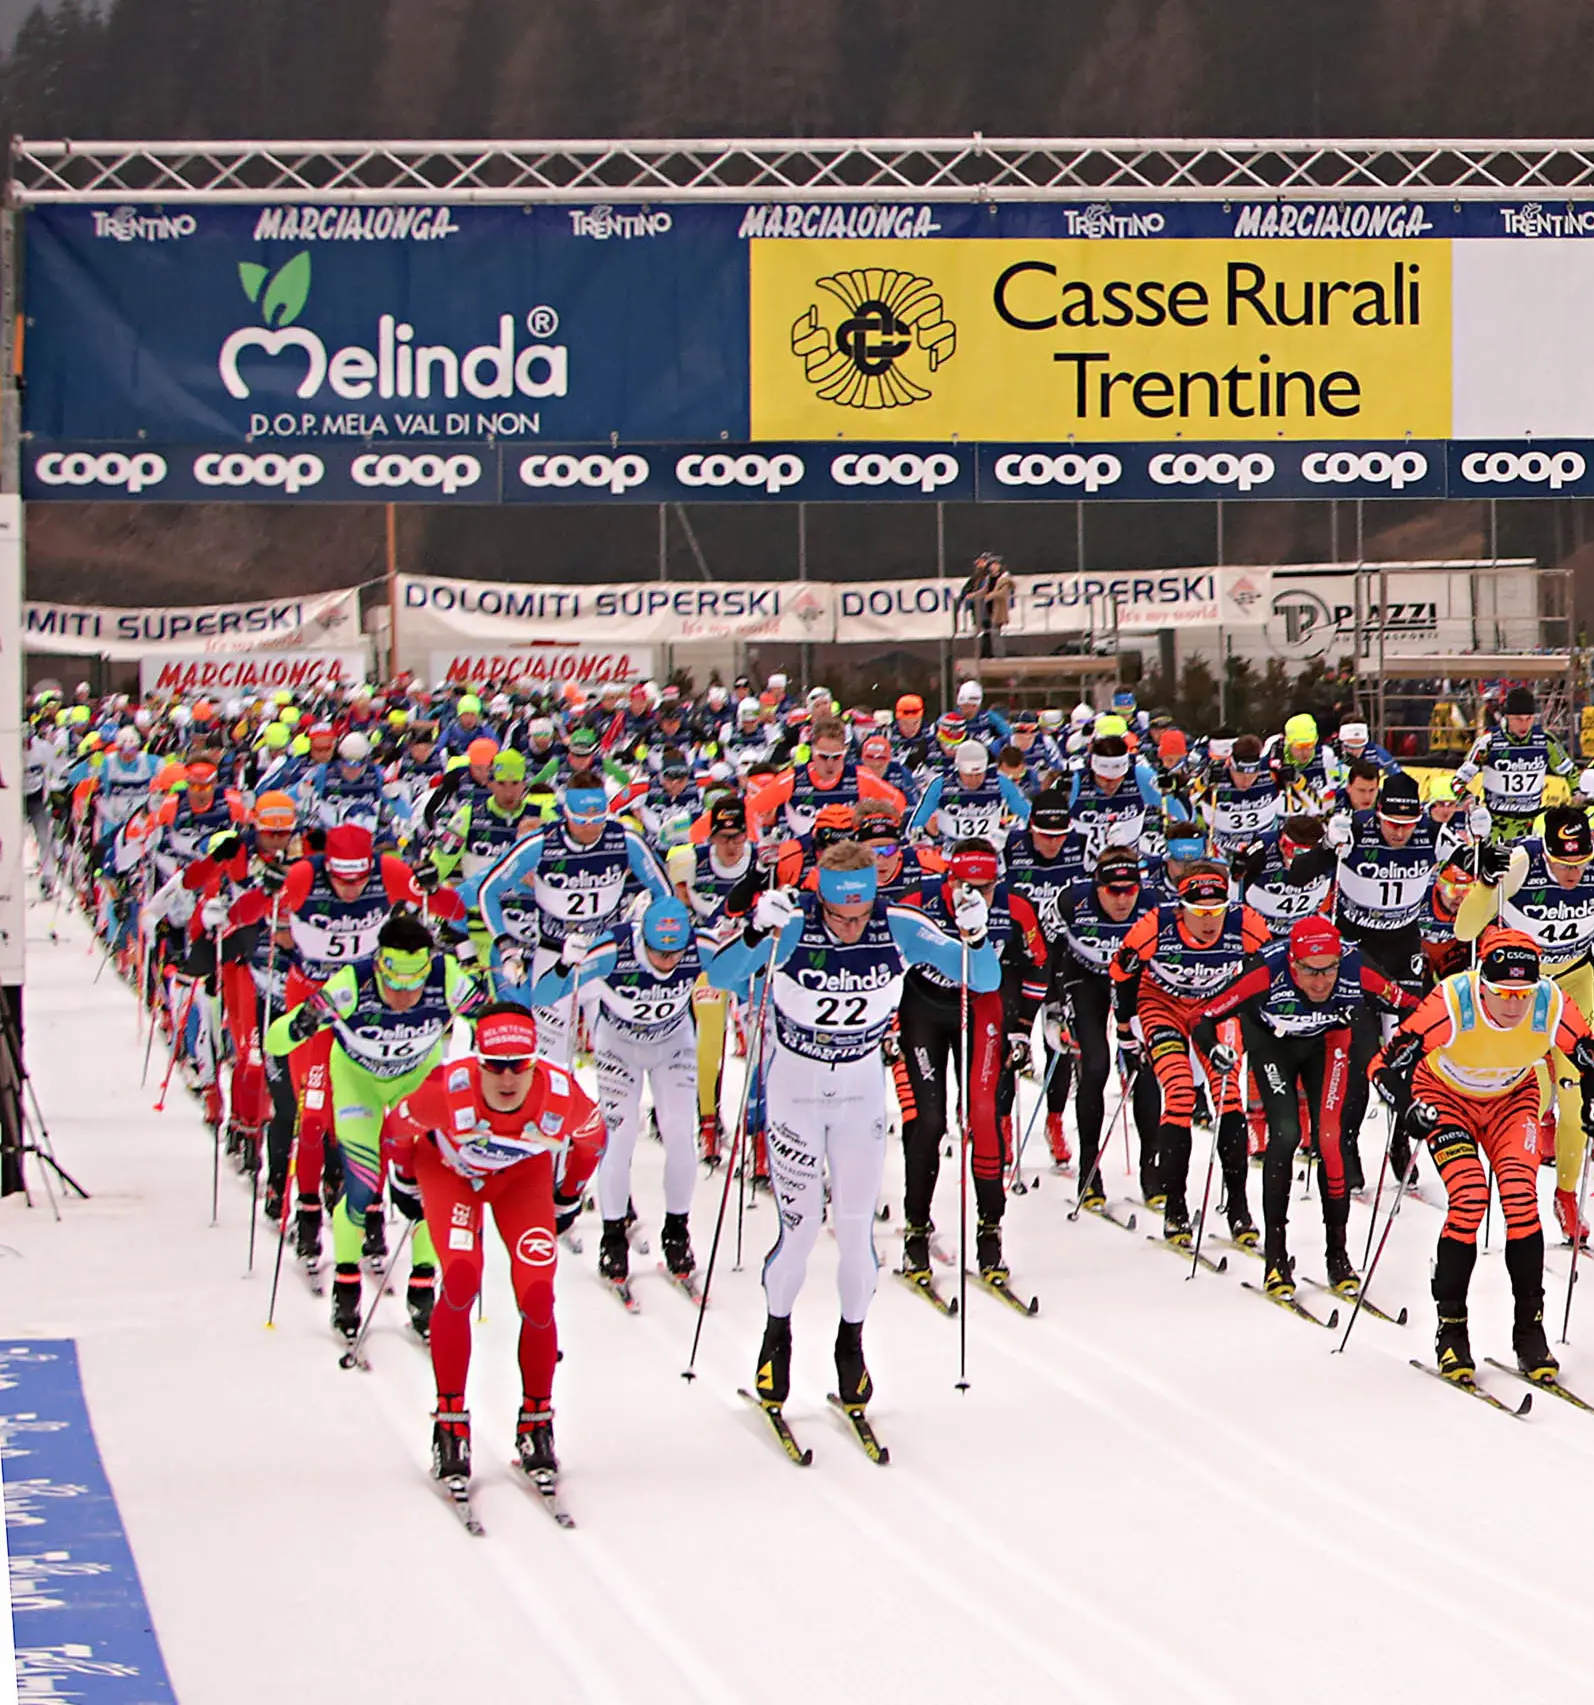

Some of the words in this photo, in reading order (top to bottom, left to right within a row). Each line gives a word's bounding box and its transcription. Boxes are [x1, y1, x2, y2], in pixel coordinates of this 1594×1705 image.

[93, 208, 197, 241] TRENTINO
[253, 207, 459, 241] MARCIALONGA
[569, 209, 672, 241] TRENTINO
[739, 206, 940, 239] MARCIALONGA
[1064, 207, 1164, 239] TRENTINO
[1234, 205, 1433, 238] MARCIALONGA
[993, 260, 1209, 331] Casse
[1227, 262, 1421, 326] Rurali
[1054, 353, 1361, 419] Trentine
[250, 413, 318, 436] D.O.P.
[322, 413, 388, 436] MELA
[394, 413, 440, 436] VAL
[445, 413, 470, 436] DI
[476, 413, 540, 436] NON
[36, 452, 167, 492] coop
[193, 452, 324, 493] coop
[351, 453, 481, 493] coop
[519, 454, 649, 494] coop
[676, 454, 803, 493] coop
[831, 453, 959, 492] coop
[994, 453, 1122, 492] coop
[1148, 452, 1275, 491] coop
[1301, 451, 1427, 490] coop
[1461, 450, 1586, 490] coop
[405, 583, 579, 618] DOLOMITI
[595, 589, 780, 617] SUPERSKI
[1032, 575, 1216, 608] SUPERSKI
[26, 608, 101, 637] MITI
[118, 602, 303, 641] SUPERSKI
[1334, 602, 1438, 624] PAZZI
[1501, 774, 1538, 793] 137
[954, 819, 990, 837] 132
[1229, 812, 1261, 829] 33
[543, 866, 626, 889] Melinda
[1357, 859, 1430, 880] Melinda
[567, 893, 600, 916] 21
[1276, 895, 1310, 915] 42
[1378, 881, 1405, 906] 11
[327, 934, 361, 958] 51
[1538, 922, 1580, 944] 44
[798, 963, 893, 993] Melinda
[633, 1002, 676, 1020] 20
[814, 996, 870, 1027] 22
[1326, 1060, 1347, 1111] Santander
